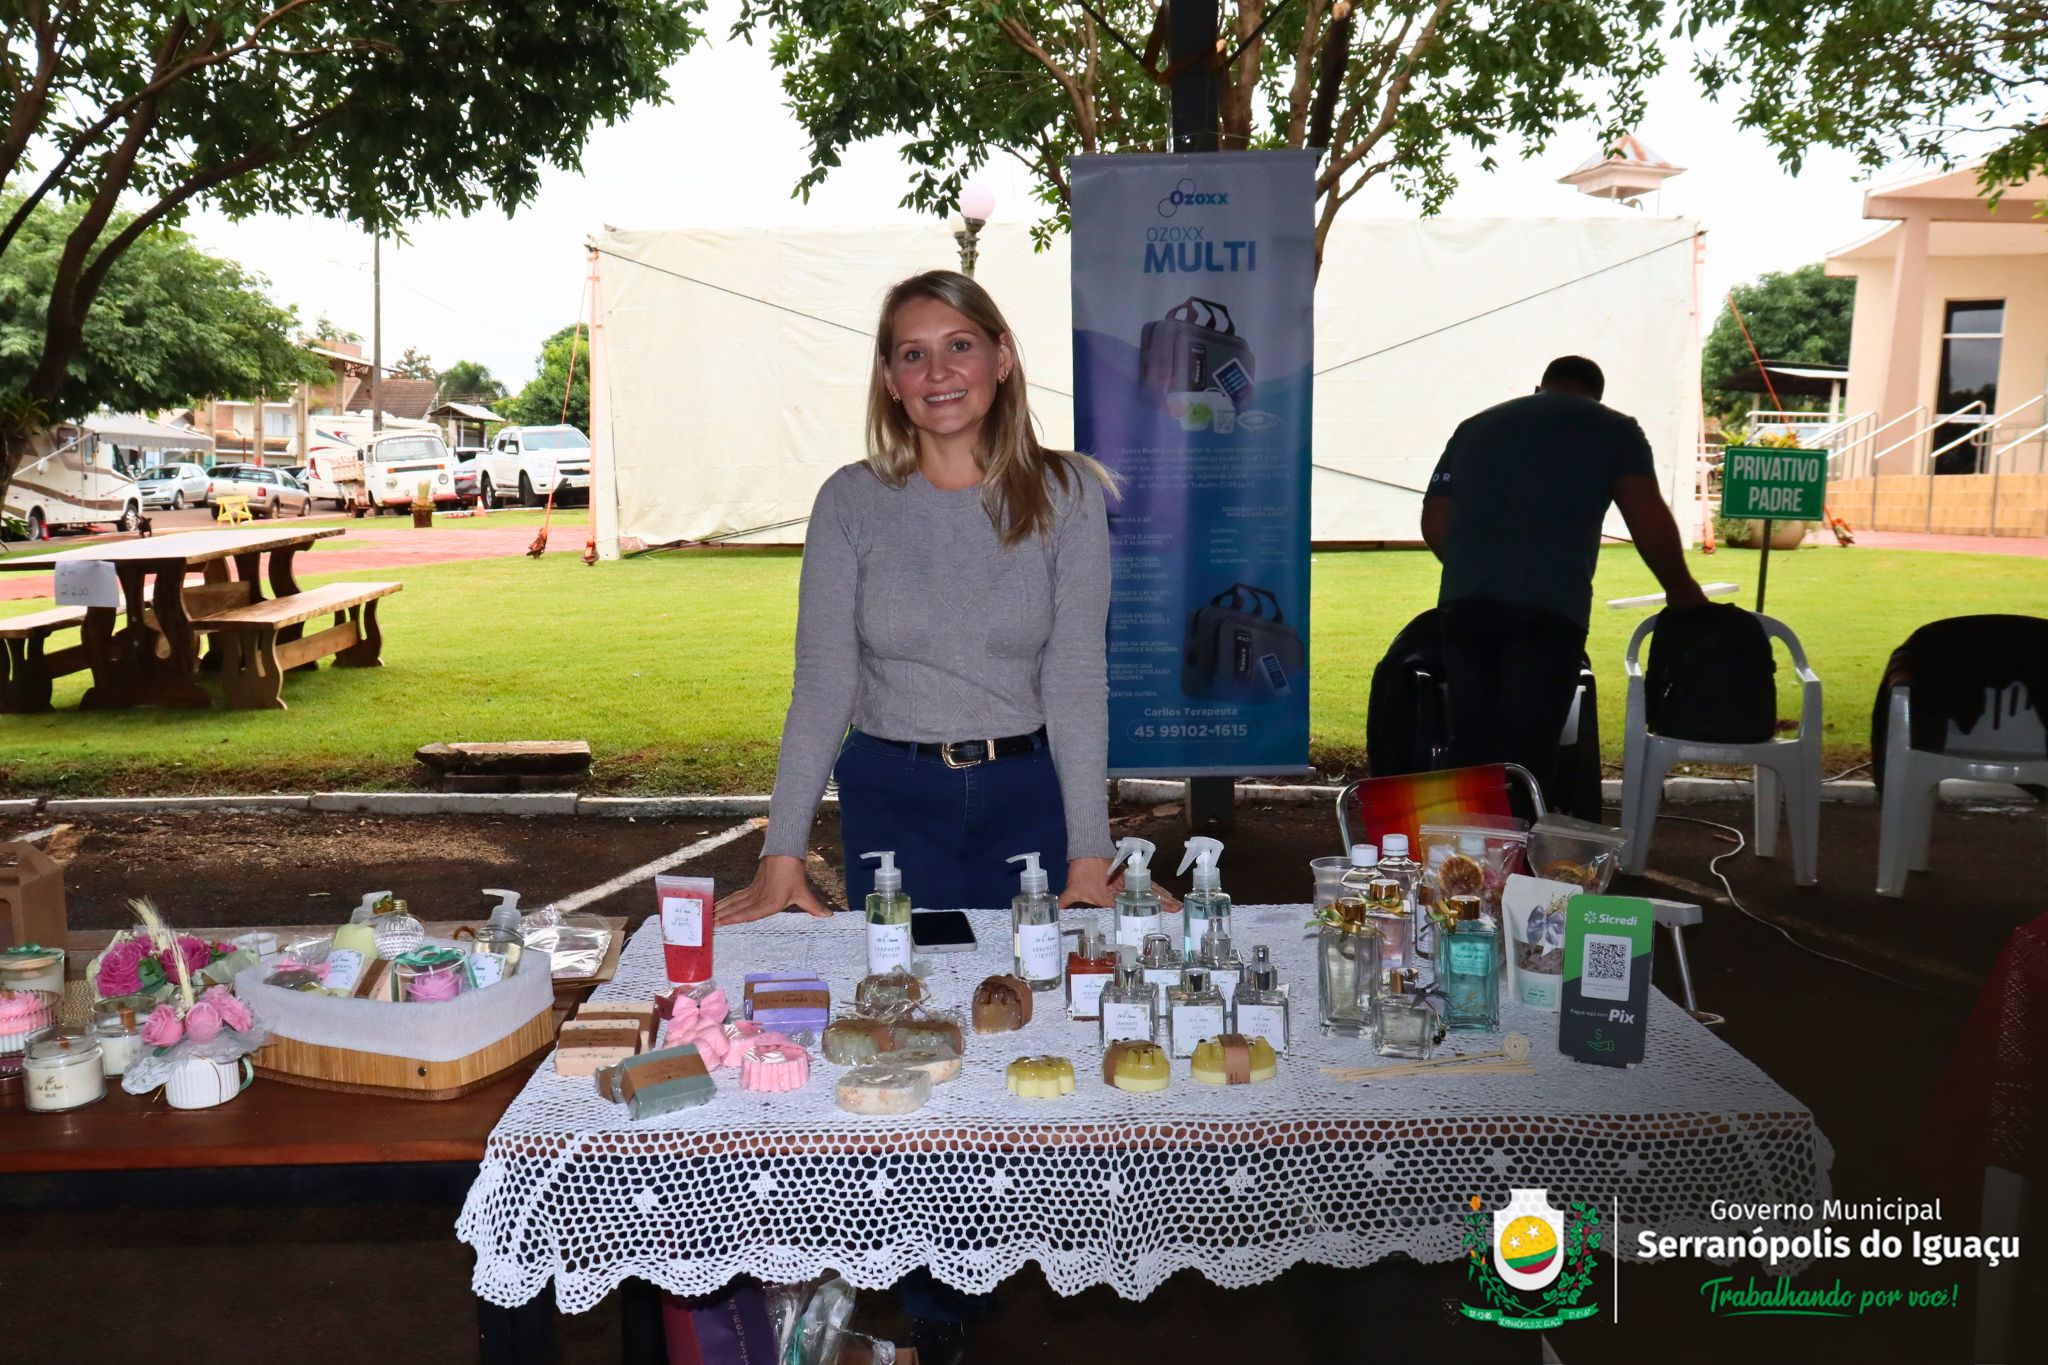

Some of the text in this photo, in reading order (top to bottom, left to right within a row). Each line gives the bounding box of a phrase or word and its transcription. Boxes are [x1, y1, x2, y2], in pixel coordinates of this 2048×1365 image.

[1170, 190, 1229, 205] Ozoxx
[1147, 226, 1204, 242] OZOXX
[1144, 241, 1256, 273] MULTI
[1733, 455, 1819, 482] PRIVATIVO
[1748, 486, 1804, 512] PADRE
[1184, 708, 1238, 717] Terapeuta
[1134, 724, 1248, 737] 45 99102-1615
[1599, 914, 1638, 926] Sicredi
[1608, 1008, 1636, 1025] Pix
